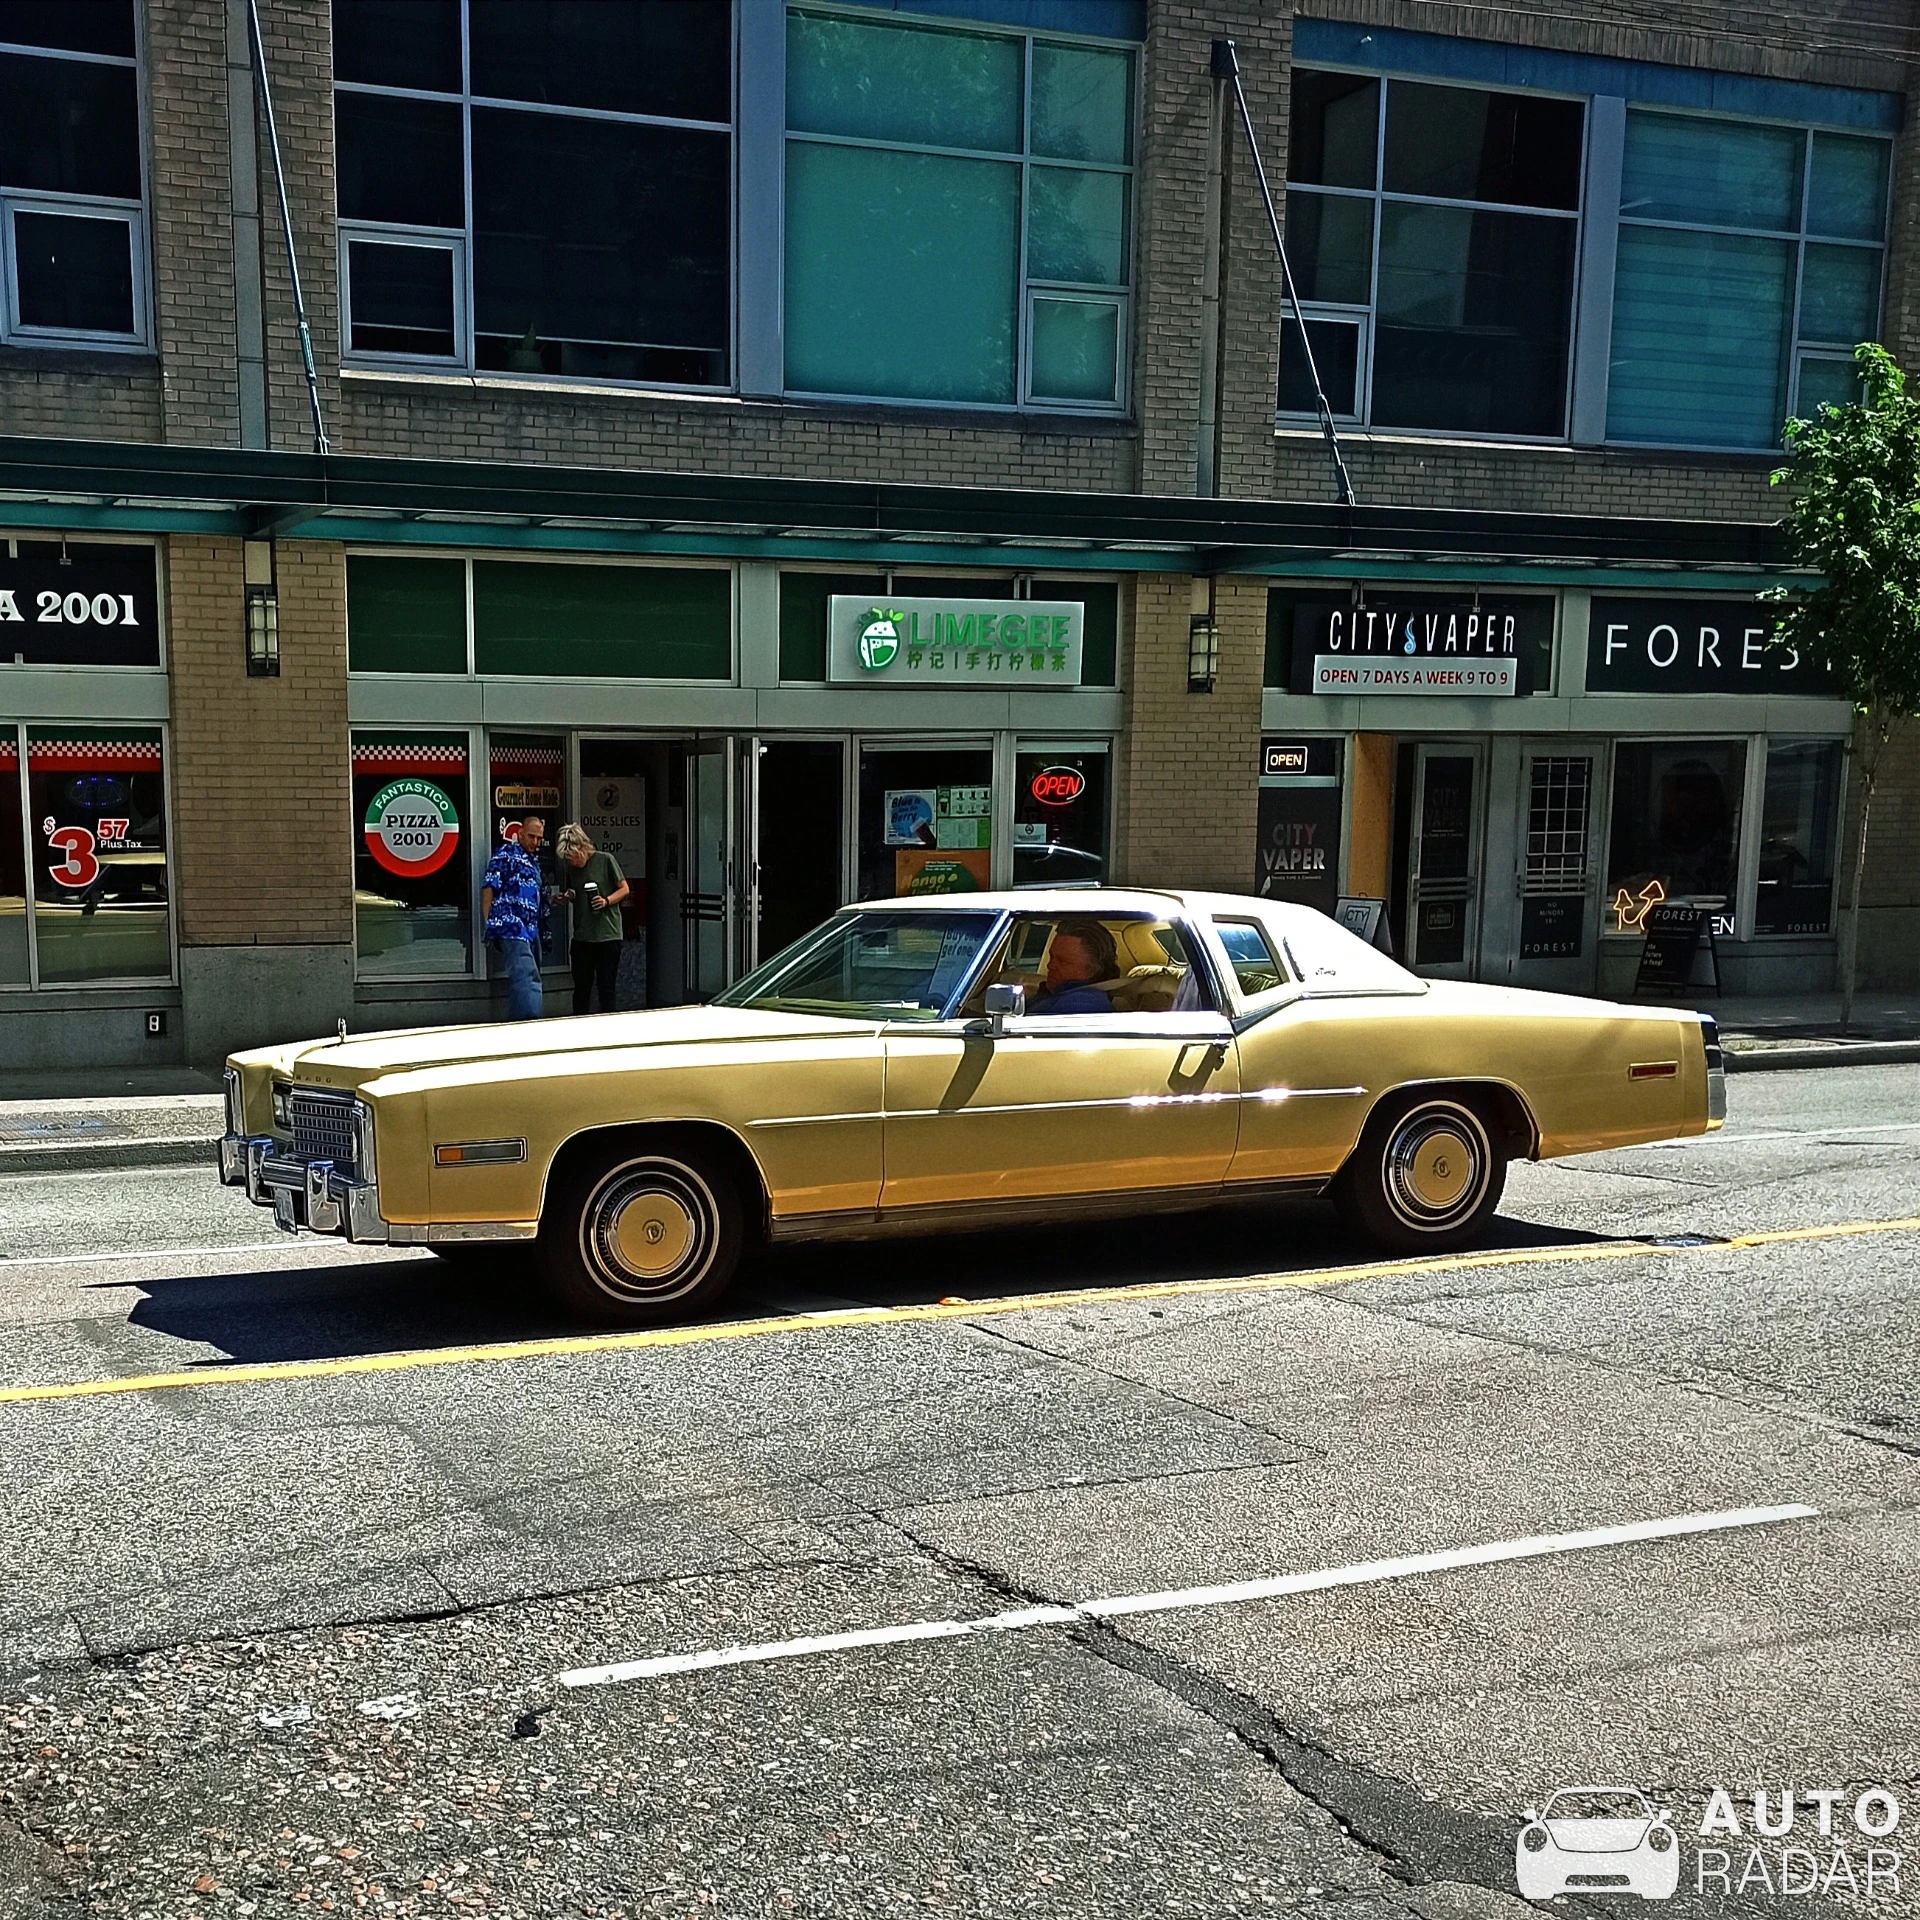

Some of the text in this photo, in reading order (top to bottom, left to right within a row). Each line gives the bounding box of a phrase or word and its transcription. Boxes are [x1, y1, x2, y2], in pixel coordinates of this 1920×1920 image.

[36, 590, 140, 626] 2001
[908, 612, 1070, 648] LIMEGEE
[1329, 610, 1515, 653] CITY VAPER
[1605, 623, 1832, 672] FORES
[1320, 669, 1508, 685] OPEN 7 DAYS A WEEK 9 TO 9
[1269, 753, 1303, 767] OPEN
[1035, 776, 1080, 796] OPEN
[374, 782, 449, 811] FANTASTICO
[497, 787, 524, 806] Gourmet
[603, 787, 615, 807] 2
[385, 814, 441, 829] PIZZA
[610, 815, 641, 827] SLICES
[392, 832, 434, 846] 2001
[603, 830, 610, 839] &
[1272, 823, 1318, 846] CITY
[100, 839, 142, 849] Plus Tax
[602, 842, 623, 853] POP
[1262, 848, 1326, 870] VAPER
[901, 873, 946, 889] Mango
[1654, 909, 1703, 921] FOREST
[946, 927, 964, 944] Buy
[1787, 923, 1827, 932] FOREST
[941, 943, 973, 958] get one
[1524, 942, 1575, 953] FOREST
